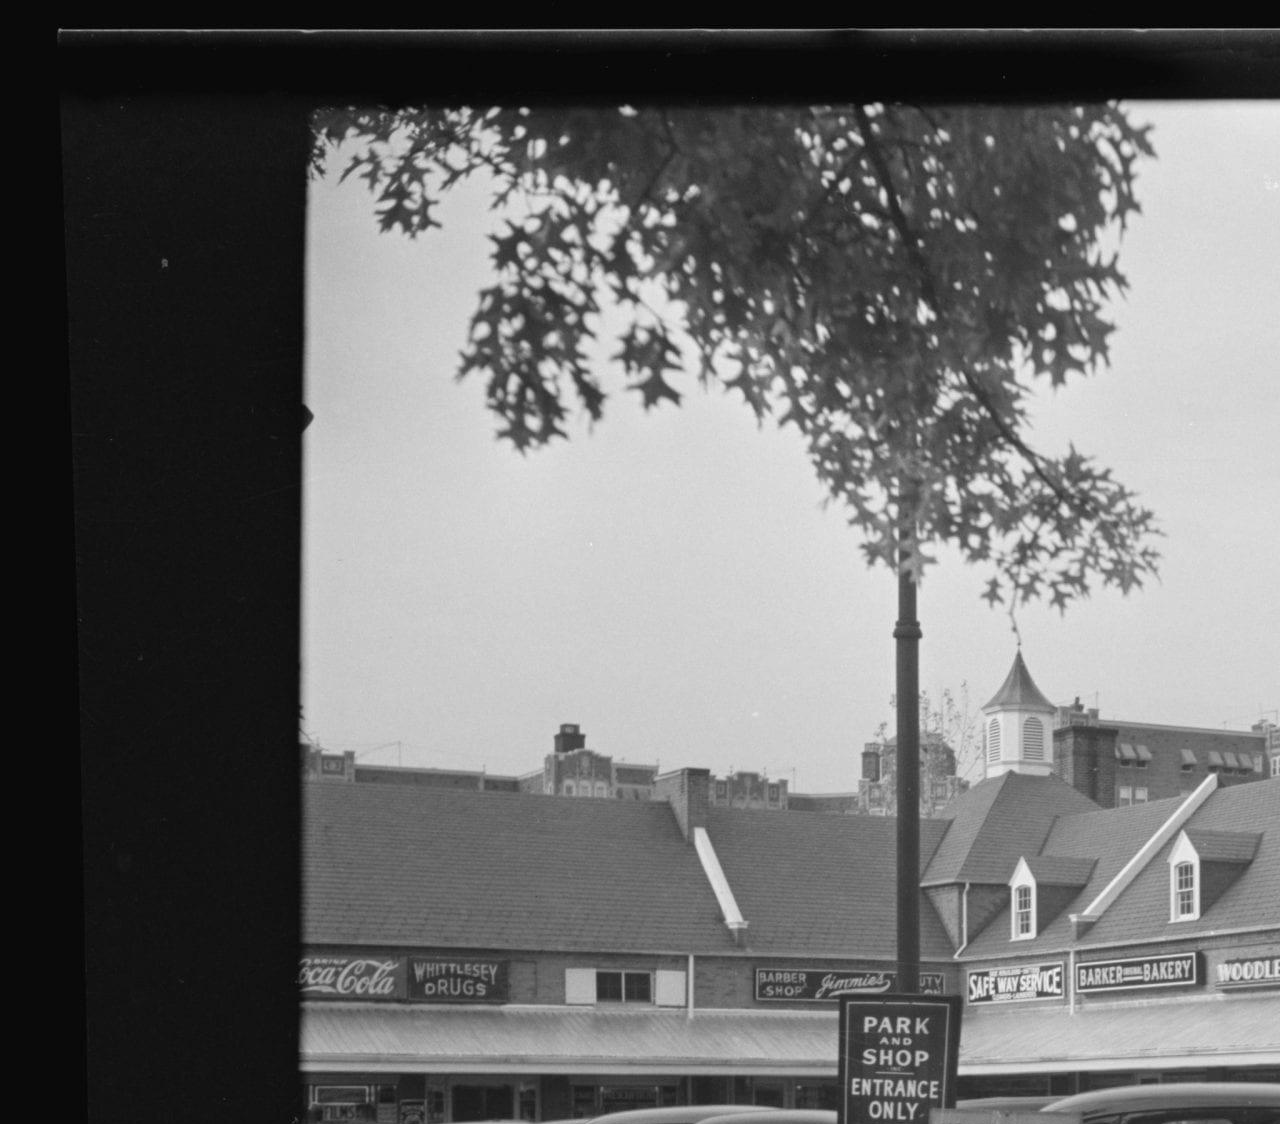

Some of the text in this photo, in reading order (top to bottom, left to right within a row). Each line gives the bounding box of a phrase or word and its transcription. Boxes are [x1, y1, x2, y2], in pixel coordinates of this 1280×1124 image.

[300, 959, 399, 995] oca-Cola
[413, 962, 498, 985] WHITTLESEY
[759, 972, 807, 984] BARBER
[1079, 965, 1123, 987] BARKER
[1143, 959, 1192, 982] BAKERY
[424, 977, 487, 996] DRUGS
[765, 985, 803, 996] SHOP
[969, 967, 1062, 1001] SAFE WAY SERVICE
[863, 1016, 931, 1035] PARK
[879, 1037, 912, 1046] AND
[862, 1048, 930, 1067] SHOP
[851, 1078, 940, 1099] ENTRANCE
[868, 1100, 919, 1121] ONLY
